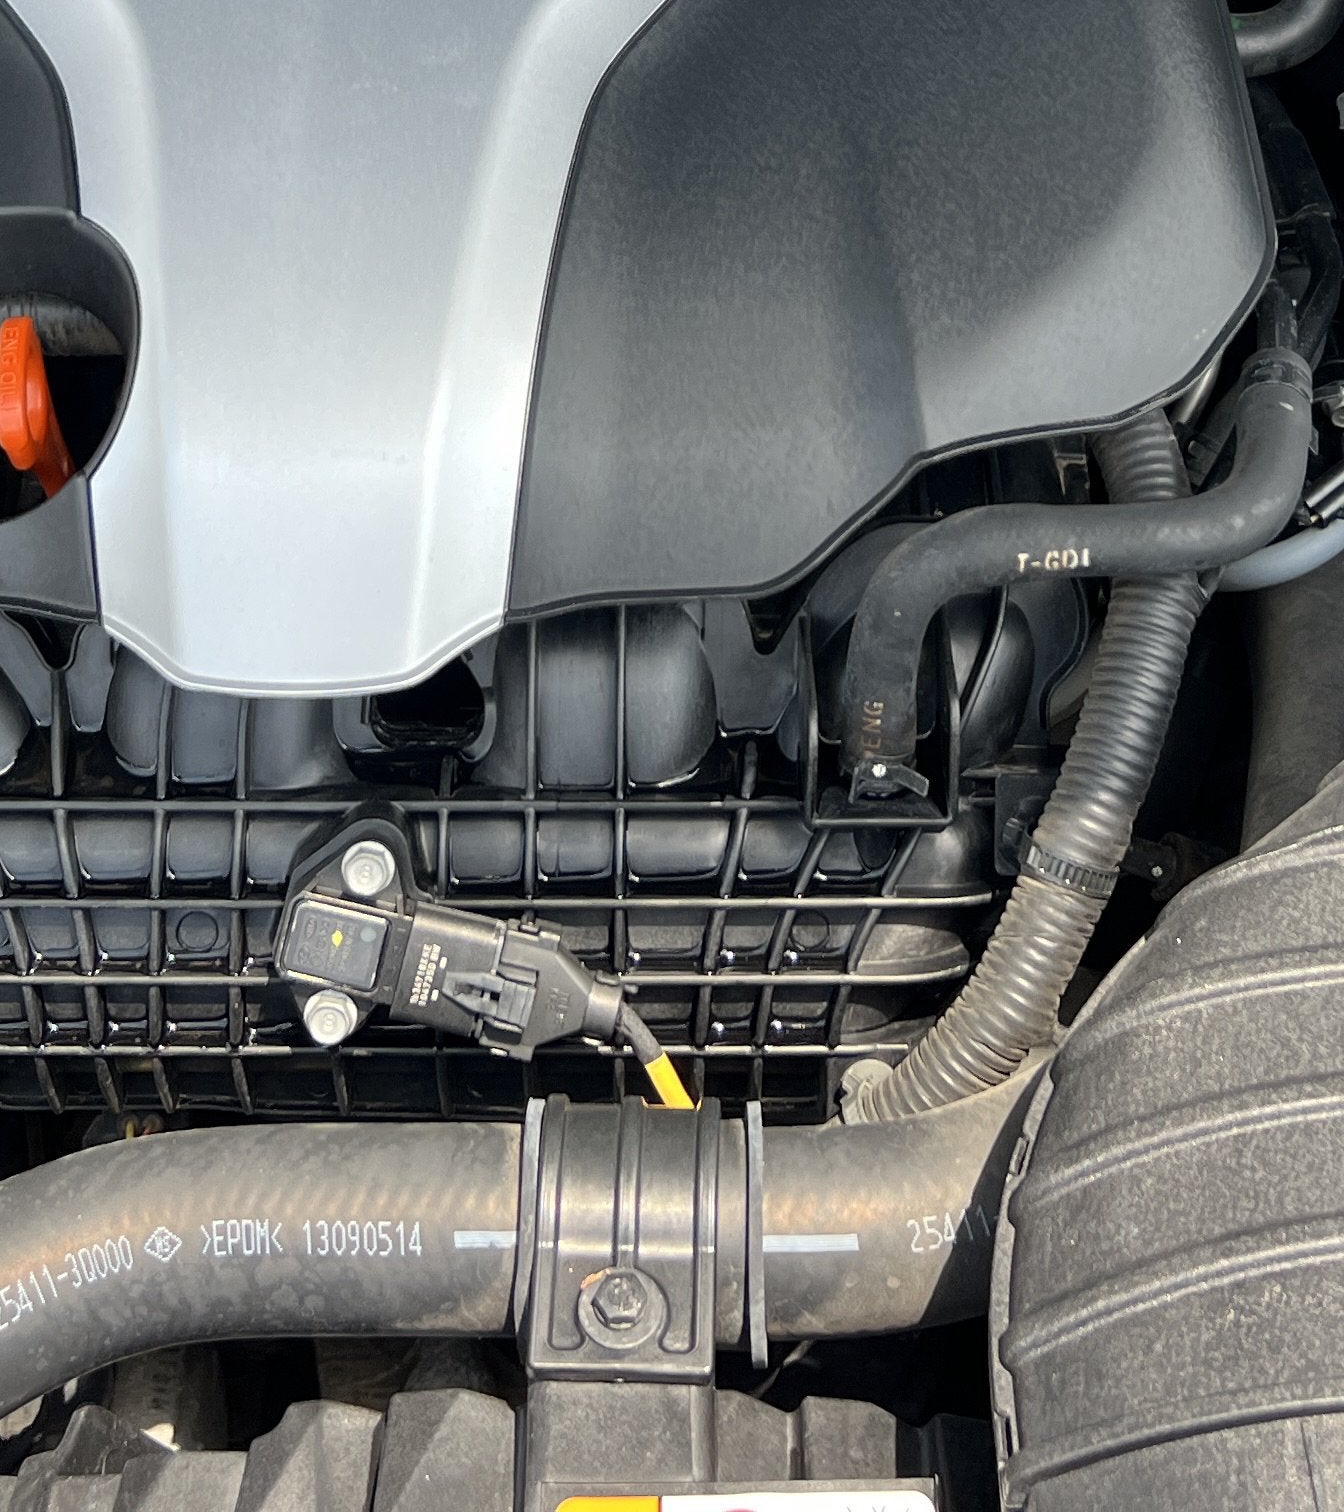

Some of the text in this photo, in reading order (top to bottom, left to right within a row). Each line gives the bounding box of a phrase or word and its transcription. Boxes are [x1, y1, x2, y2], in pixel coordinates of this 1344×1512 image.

[0, 326, 20, 400] ENG OIL
[1017, 547, 1090, 573] T-GDI
[201, 1218, 284, 1257] >EPDM<
[302, 1219, 423, 1257] 13090514
